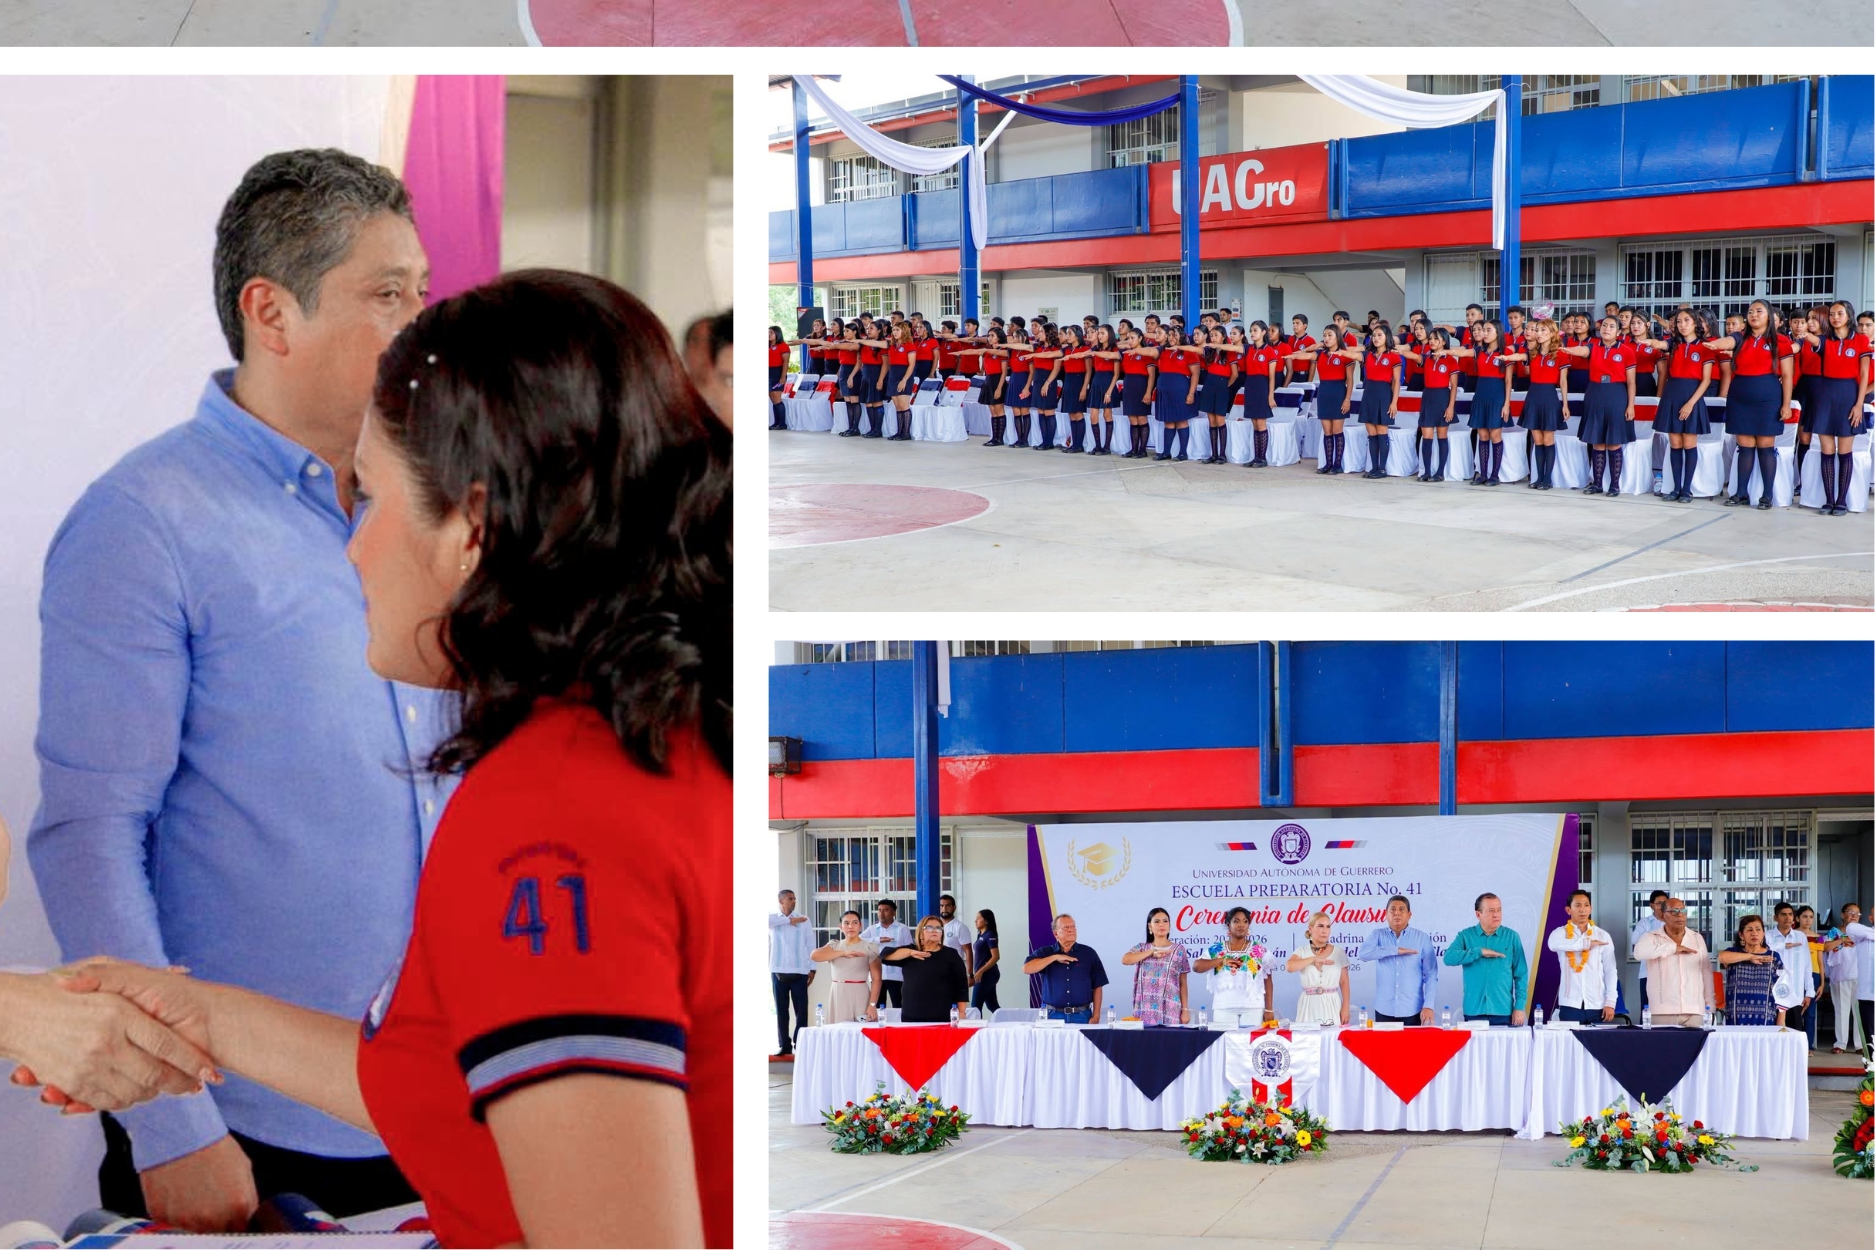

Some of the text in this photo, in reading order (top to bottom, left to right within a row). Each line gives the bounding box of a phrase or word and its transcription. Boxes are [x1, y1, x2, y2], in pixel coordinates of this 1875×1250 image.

[1192, 866, 1394, 879] UNIVERSIDAD AUTÓNOMA DE GUERRERO
[1171, 882, 1423, 899] ESCUELA PREPARATORIA No. 41
[502, 875, 591, 956] 41
[1175, 904, 1283, 932] Cerenia
[1287, 901, 1310, 924] de
[1168, 934, 1211, 945] eración:
[1326, 932, 1365, 944] adrina
